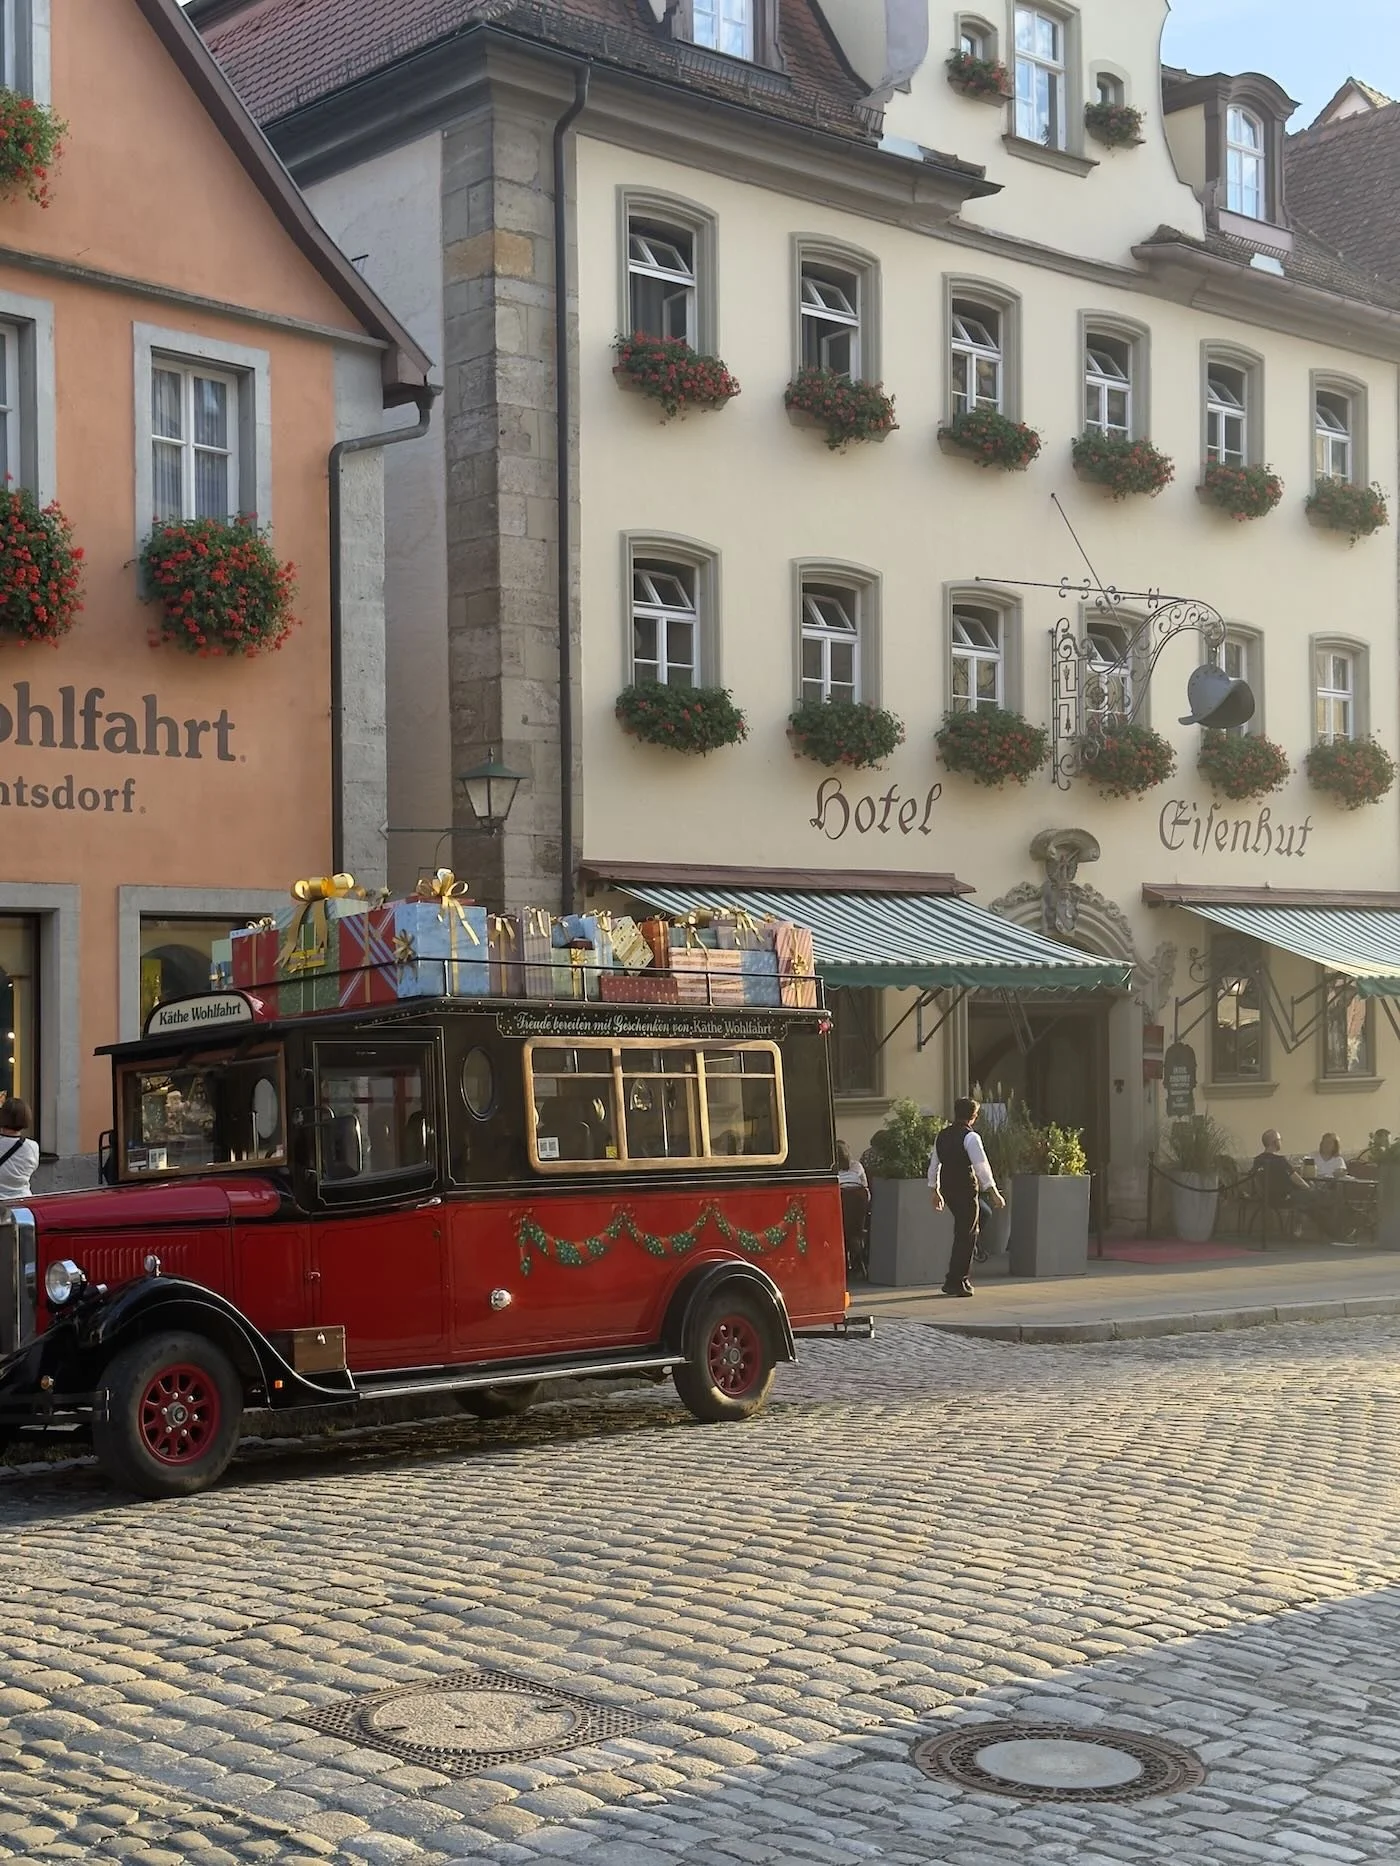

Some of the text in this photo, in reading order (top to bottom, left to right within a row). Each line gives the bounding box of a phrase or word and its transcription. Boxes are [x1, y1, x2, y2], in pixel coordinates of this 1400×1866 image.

[809, 777, 942, 840] Hotel
[159, 1002, 241, 1026] Käthe Wohlfahrt
[516, 1011, 772, 1035] Freude bereiten mit Geschenken von Käthe Wohlfahrt
